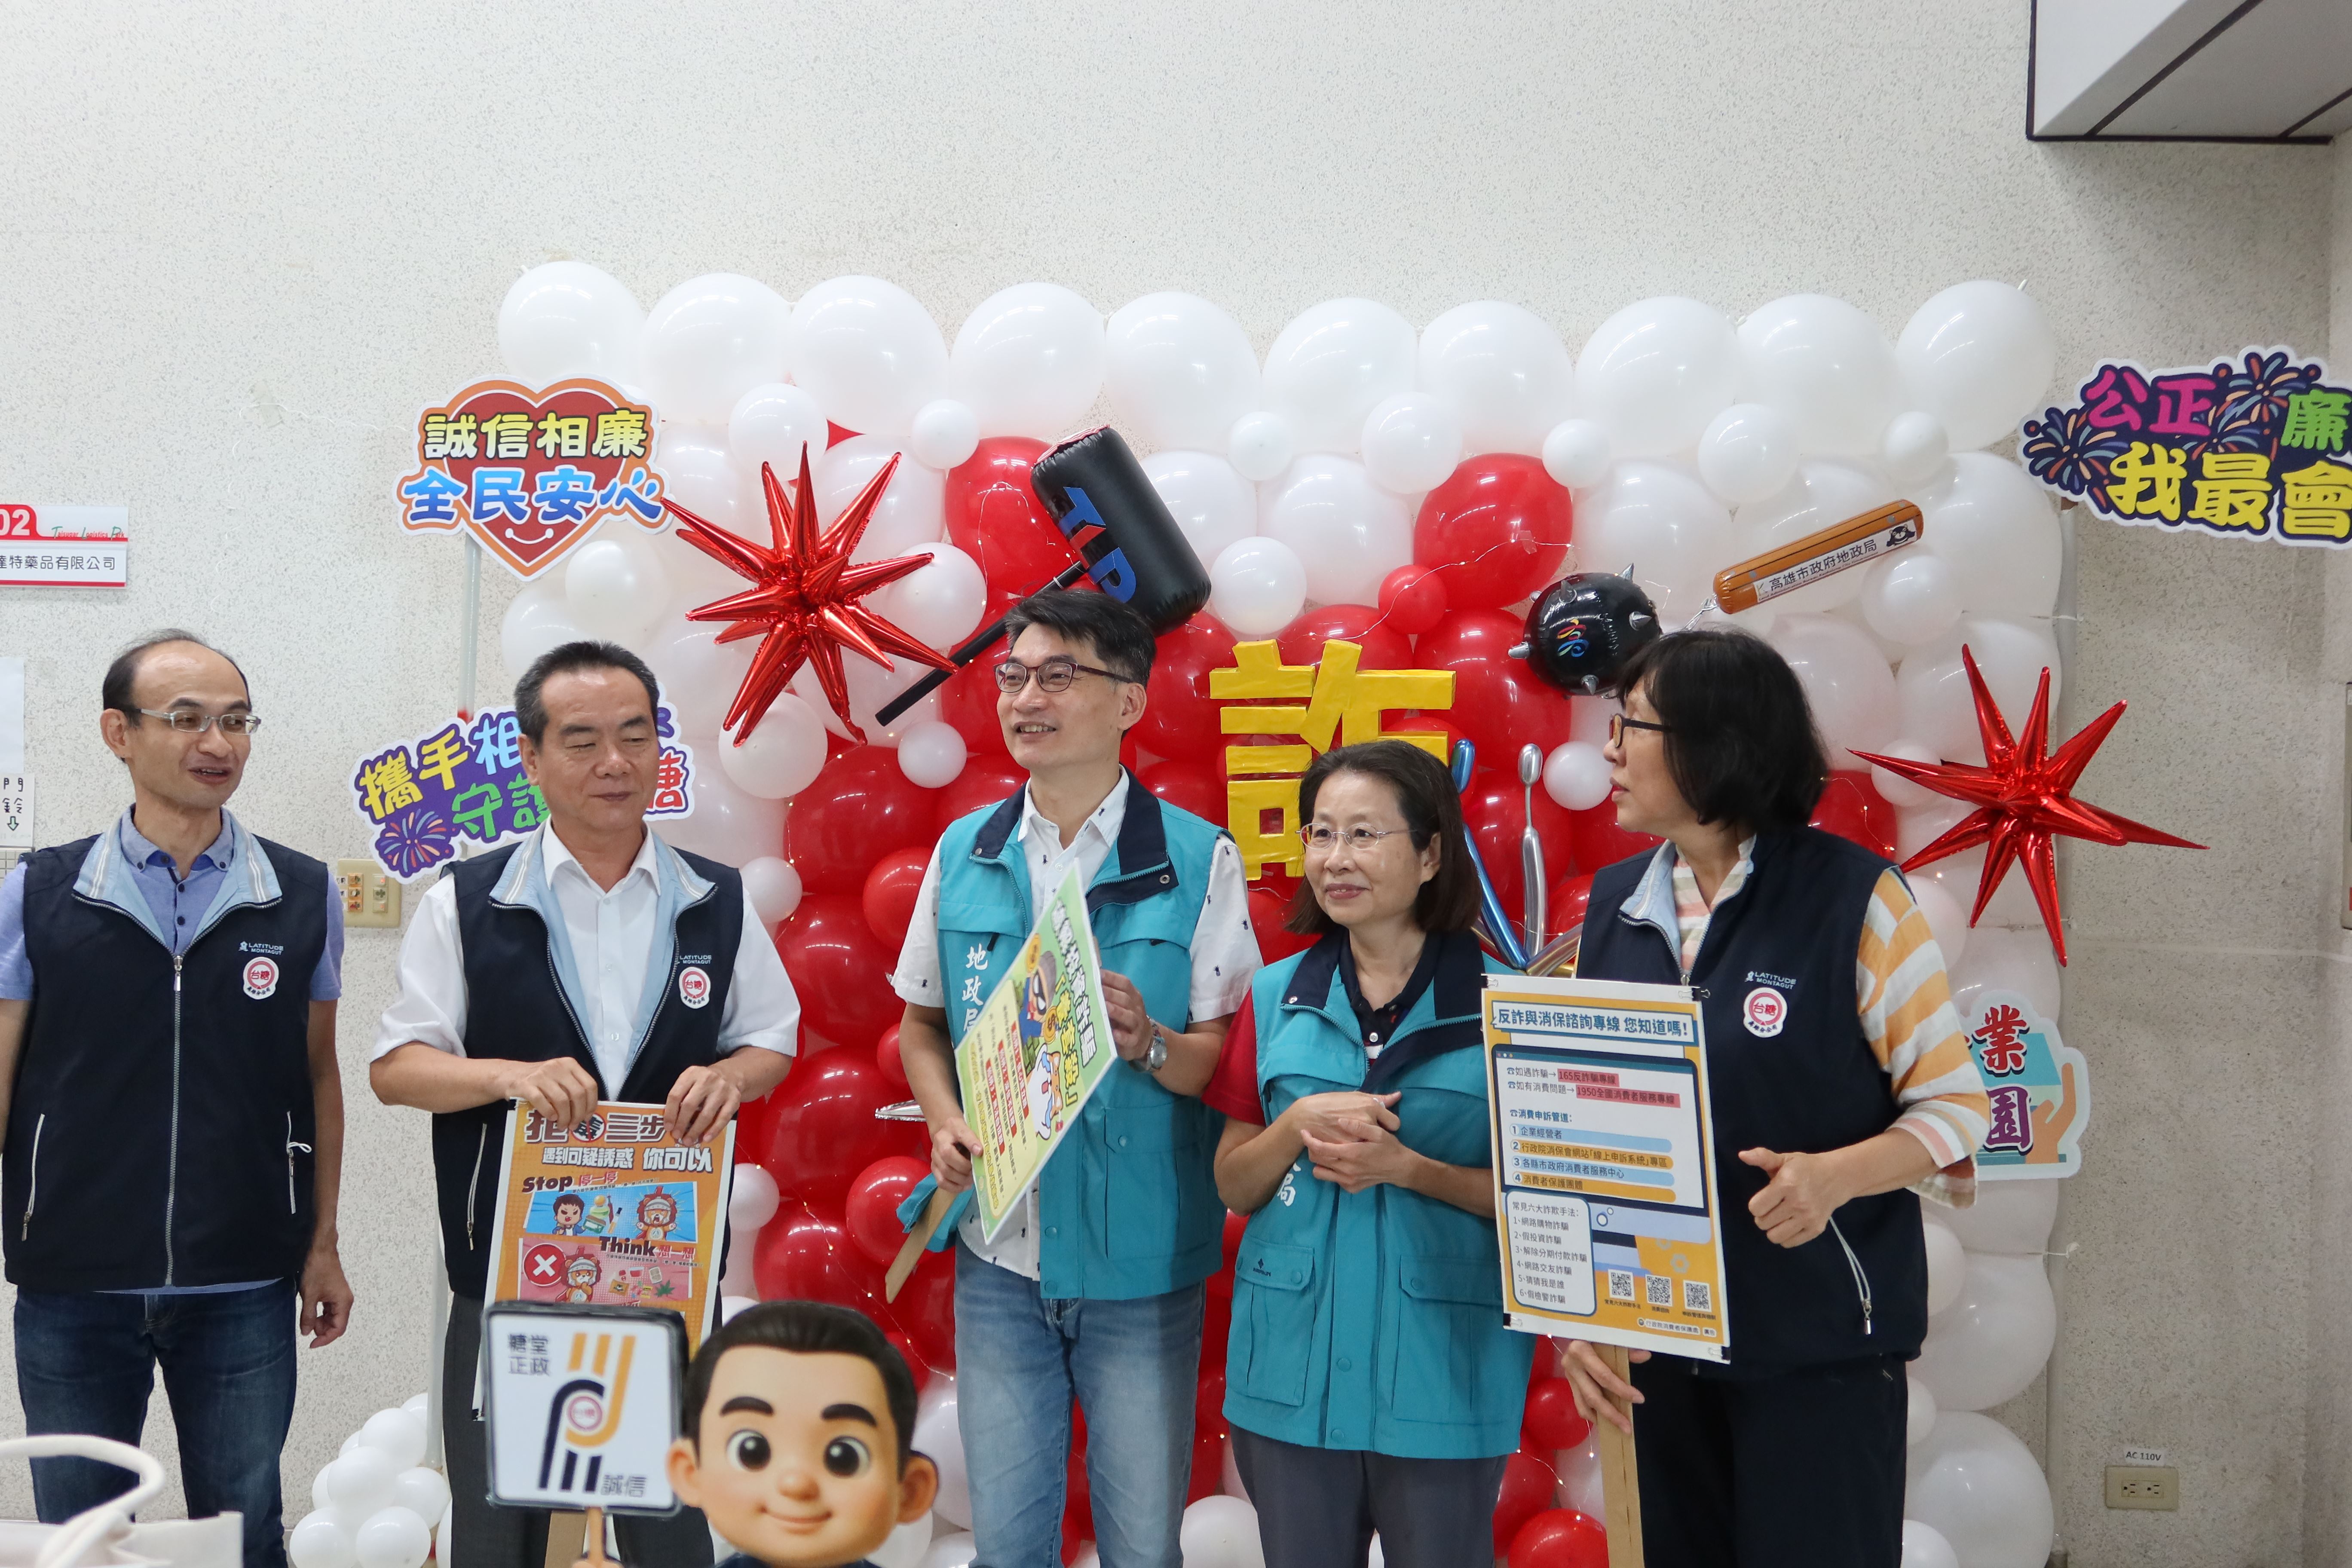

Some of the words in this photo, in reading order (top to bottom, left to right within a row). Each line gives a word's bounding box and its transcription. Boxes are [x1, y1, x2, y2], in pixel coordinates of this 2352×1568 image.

[2086, 369, 2352, 451] 公正廉
[423, 408, 647, 459] 誠信相廉
[403, 467, 663, 521] 全民安心
[2106, 441, 2352, 538] 我最會
[51, 526, 79, 539] Taisugar
[81, 527, 108, 539] Logistics
[110, 526, 125, 540] Park
[1769, 539, 1877, 591] 高雄市政府地政局
[359, 716, 522, 821] 攜手相
[1209, 639, 1457, 881] 詐
[248, 943, 284, 951] LATITUDE
[250, 970, 270, 980] 台糖
[1755, 971, 1797, 985] LATITUDE
[1756, 977, 1794, 989] MONTAGUT
[685, 980, 703, 990] 台糖
[1754, 1002, 1777, 1016] 台糖
[1498, 1009, 1620, 1032] 反詐與消保諮詢專線
[1623, 1017, 1688, 1037] 您知道嗎!
[1515, 1066, 1549, 1079] 如遇詐騙
[1559, 1071, 1616, 1085] 165反詐騙專線
[1516, 1081, 1567, 1095] 如有消費問題
[1577, 1087, 1675, 1105] 1950全國消費者服務專線
[1520, 1126, 1563, 1139] 企業經營者
[542, 1147, 634, 1169] 遇到可疑誘惑
[642, 1147, 713, 1172] 你可以
[1522, 1158, 1624, 1179] 各縣市政府消費者服務中心
[522, 1176, 573, 1194] Stop
[578, 1171, 619, 1186] 停一停
[1523, 1174, 1583, 1190] 消費者保護團體
[1513, 1216, 1569, 1231] 1、網路購物詐騙
[1514, 1231, 1562, 1245] 2、假投資詐騙
[599, 1236, 658, 1257] Think
[659, 1245, 695, 1260] 想一想
[1515, 1246, 1588, 1263] 3、解除分期付款詐騙
[1517, 1260, 1572, 1276] 4、網路交友詐騙
[1518, 1274, 1565, 1289] 5、猜猜我是誰
[1519, 1289, 1566, 1305] 6、假檢警詐騙
[508, 1333, 549, 1355] 糖堂
[508, 1356, 551, 1376] 正政
[2141, 1452, 2161, 1461] 110V
[601, 1473, 648, 1498] 誠信
